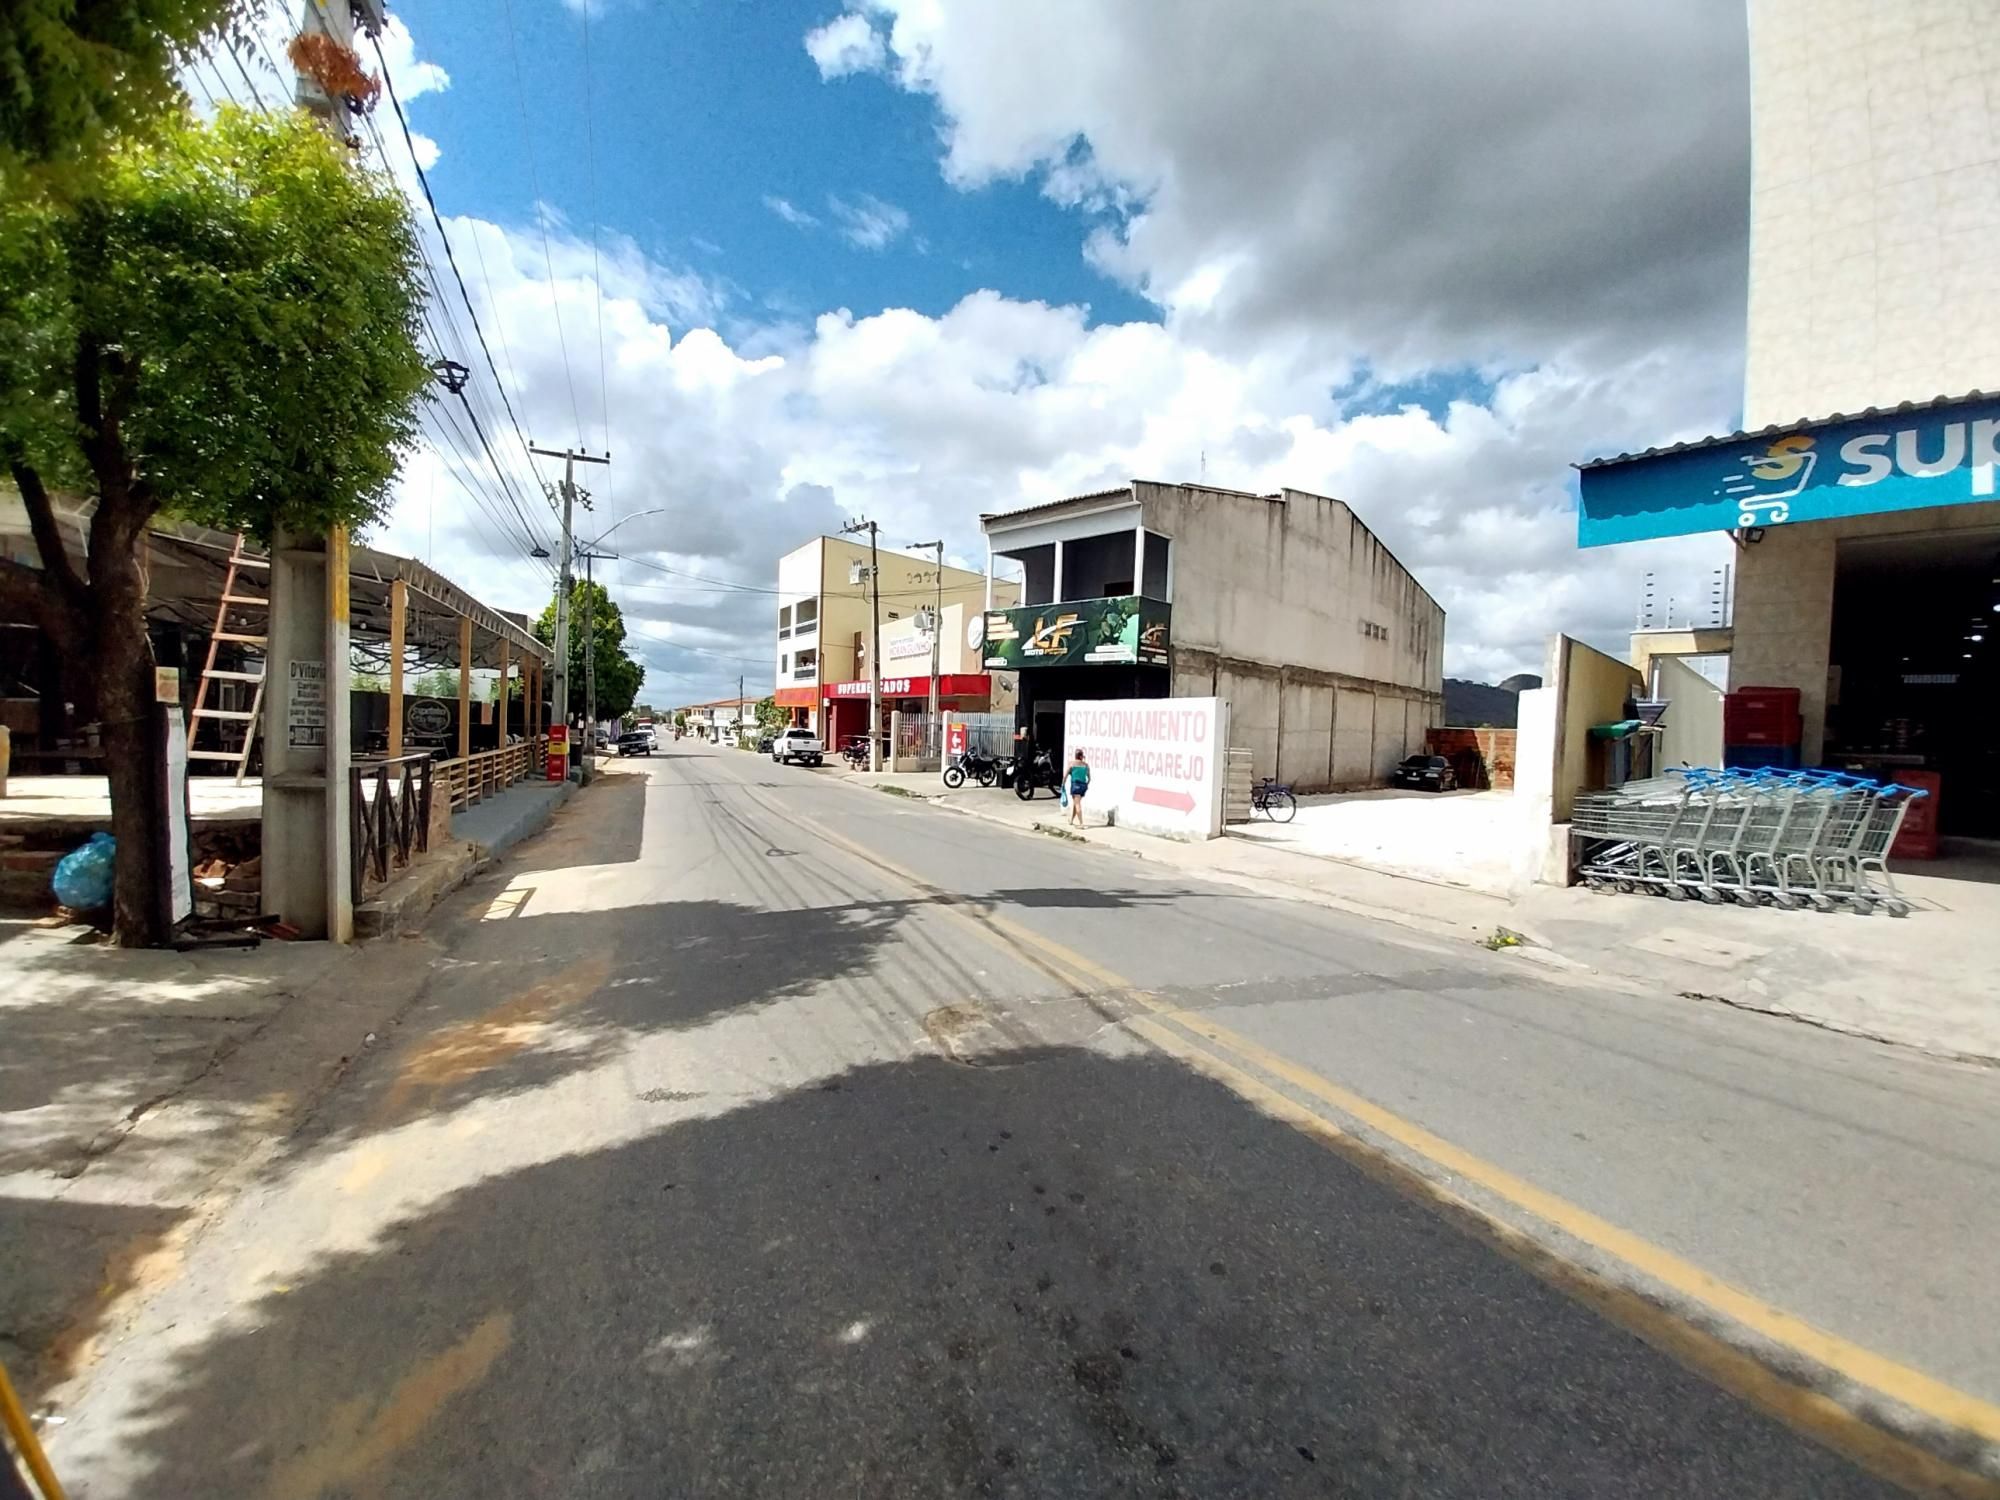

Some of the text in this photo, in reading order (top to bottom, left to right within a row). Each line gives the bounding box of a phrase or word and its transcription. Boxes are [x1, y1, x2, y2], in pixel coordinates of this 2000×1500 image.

[837, 679, 911, 695] SUPERMECADOS
[1068, 710, 1207, 743] ESTACIONAMENTO
[1123, 750, 1204, 782] ATACAREJO
